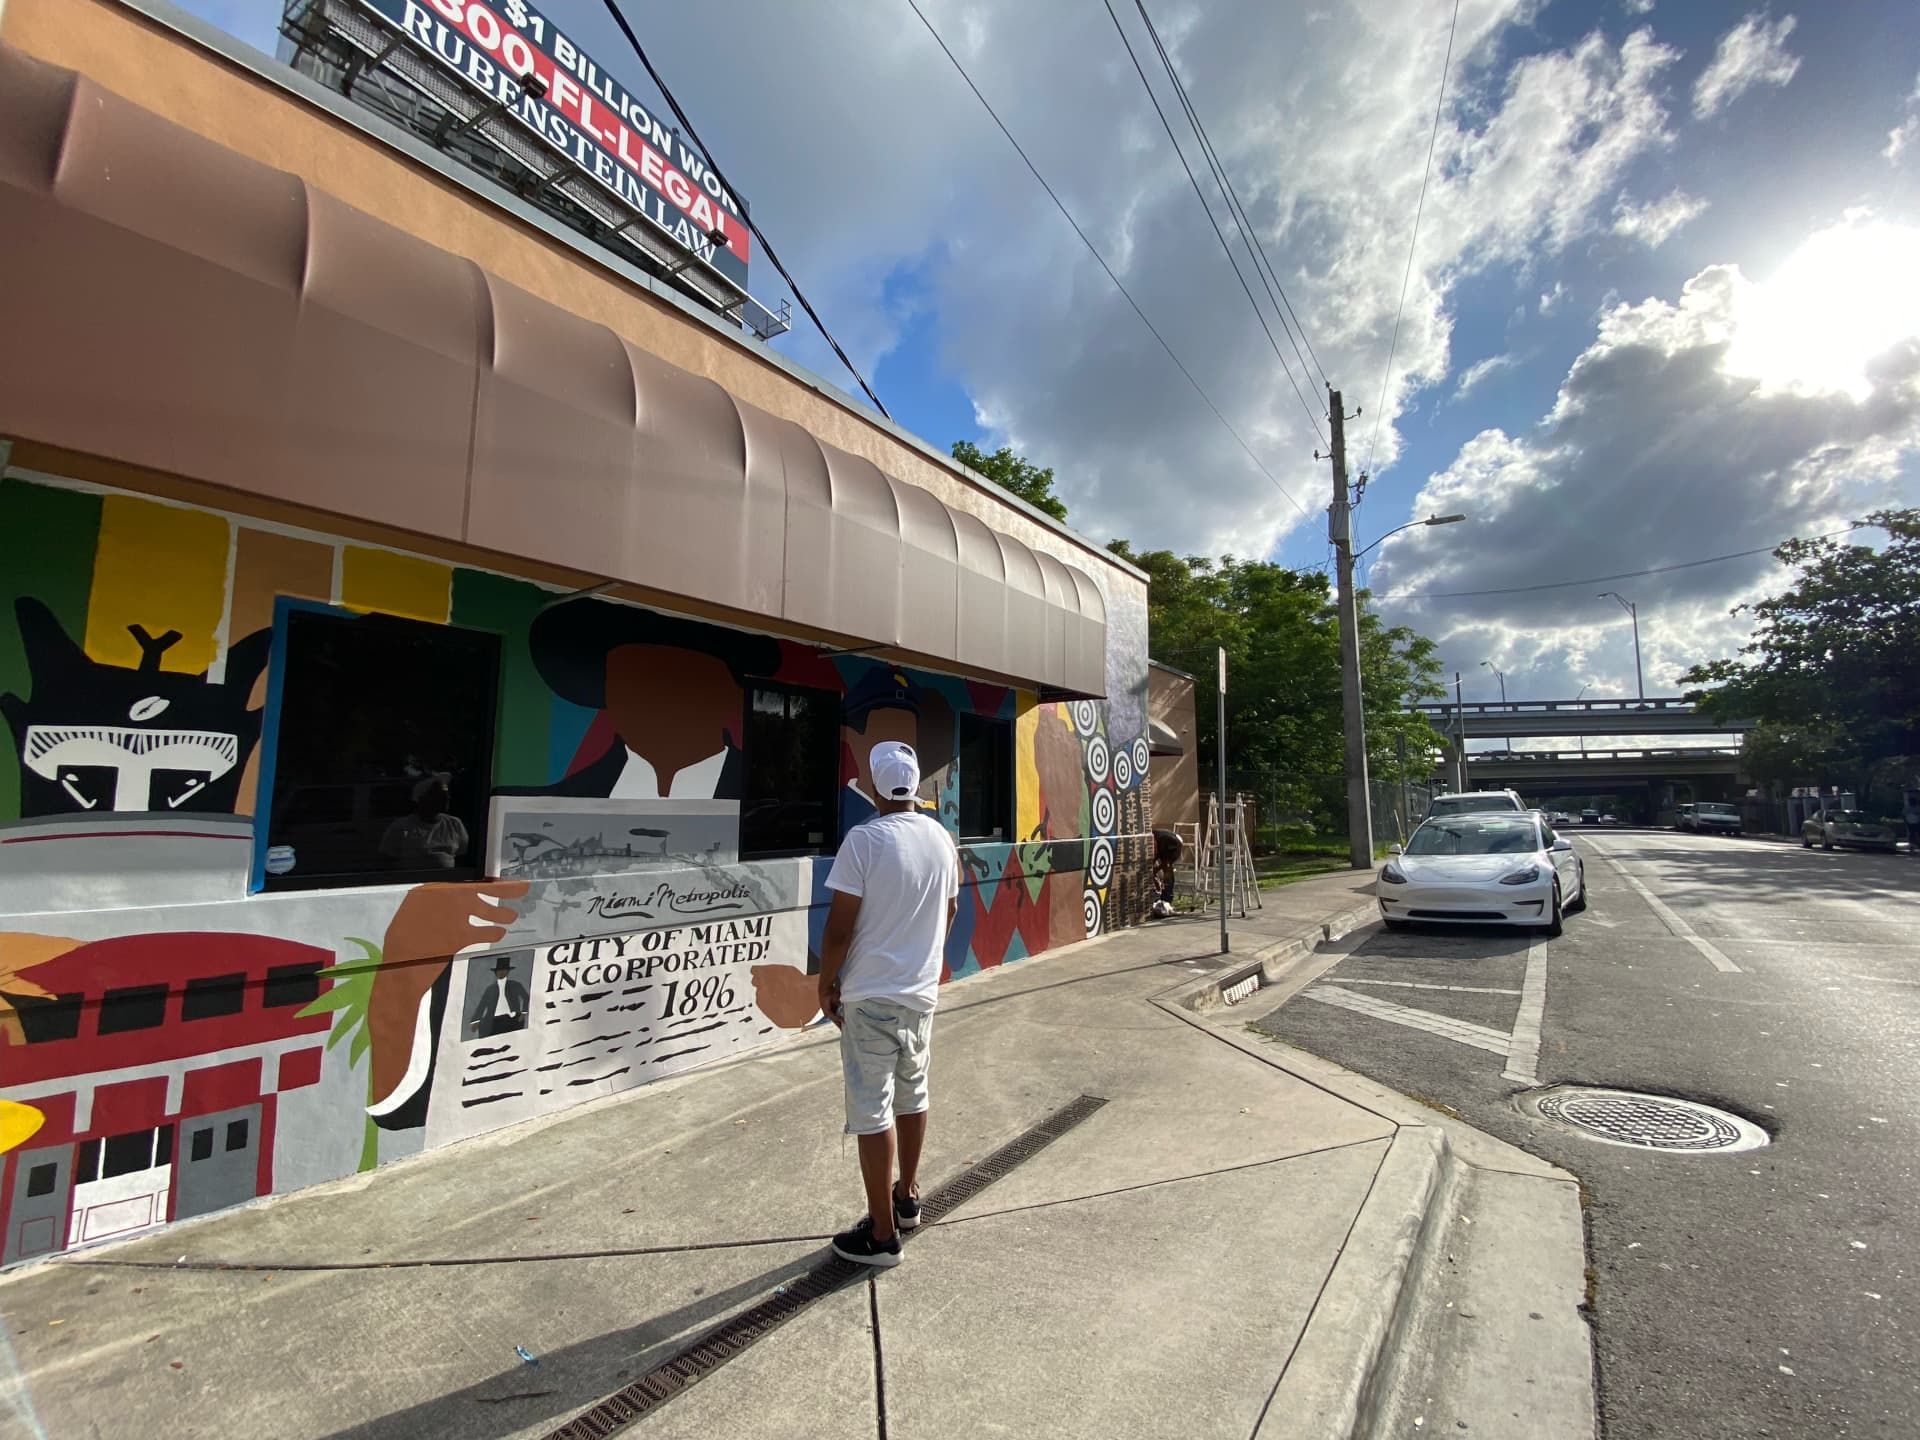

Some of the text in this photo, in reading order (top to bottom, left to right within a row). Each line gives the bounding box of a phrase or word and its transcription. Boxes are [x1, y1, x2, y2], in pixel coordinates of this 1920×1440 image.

[401, 2, 717, 263] RUBENSTEIN LAW
[504, 0, 544, 44] $1
[554, 33, 672, 157] BILLION
[678, 143, 739, 216] WON
[587, 883, 751, 919] Miami Metropolis
[545, 940, 772, 993] INCORPORATED!
[547, 916, 774, 966] CITY OF MIAMI
[657, 973, 734, 1020] 1896
